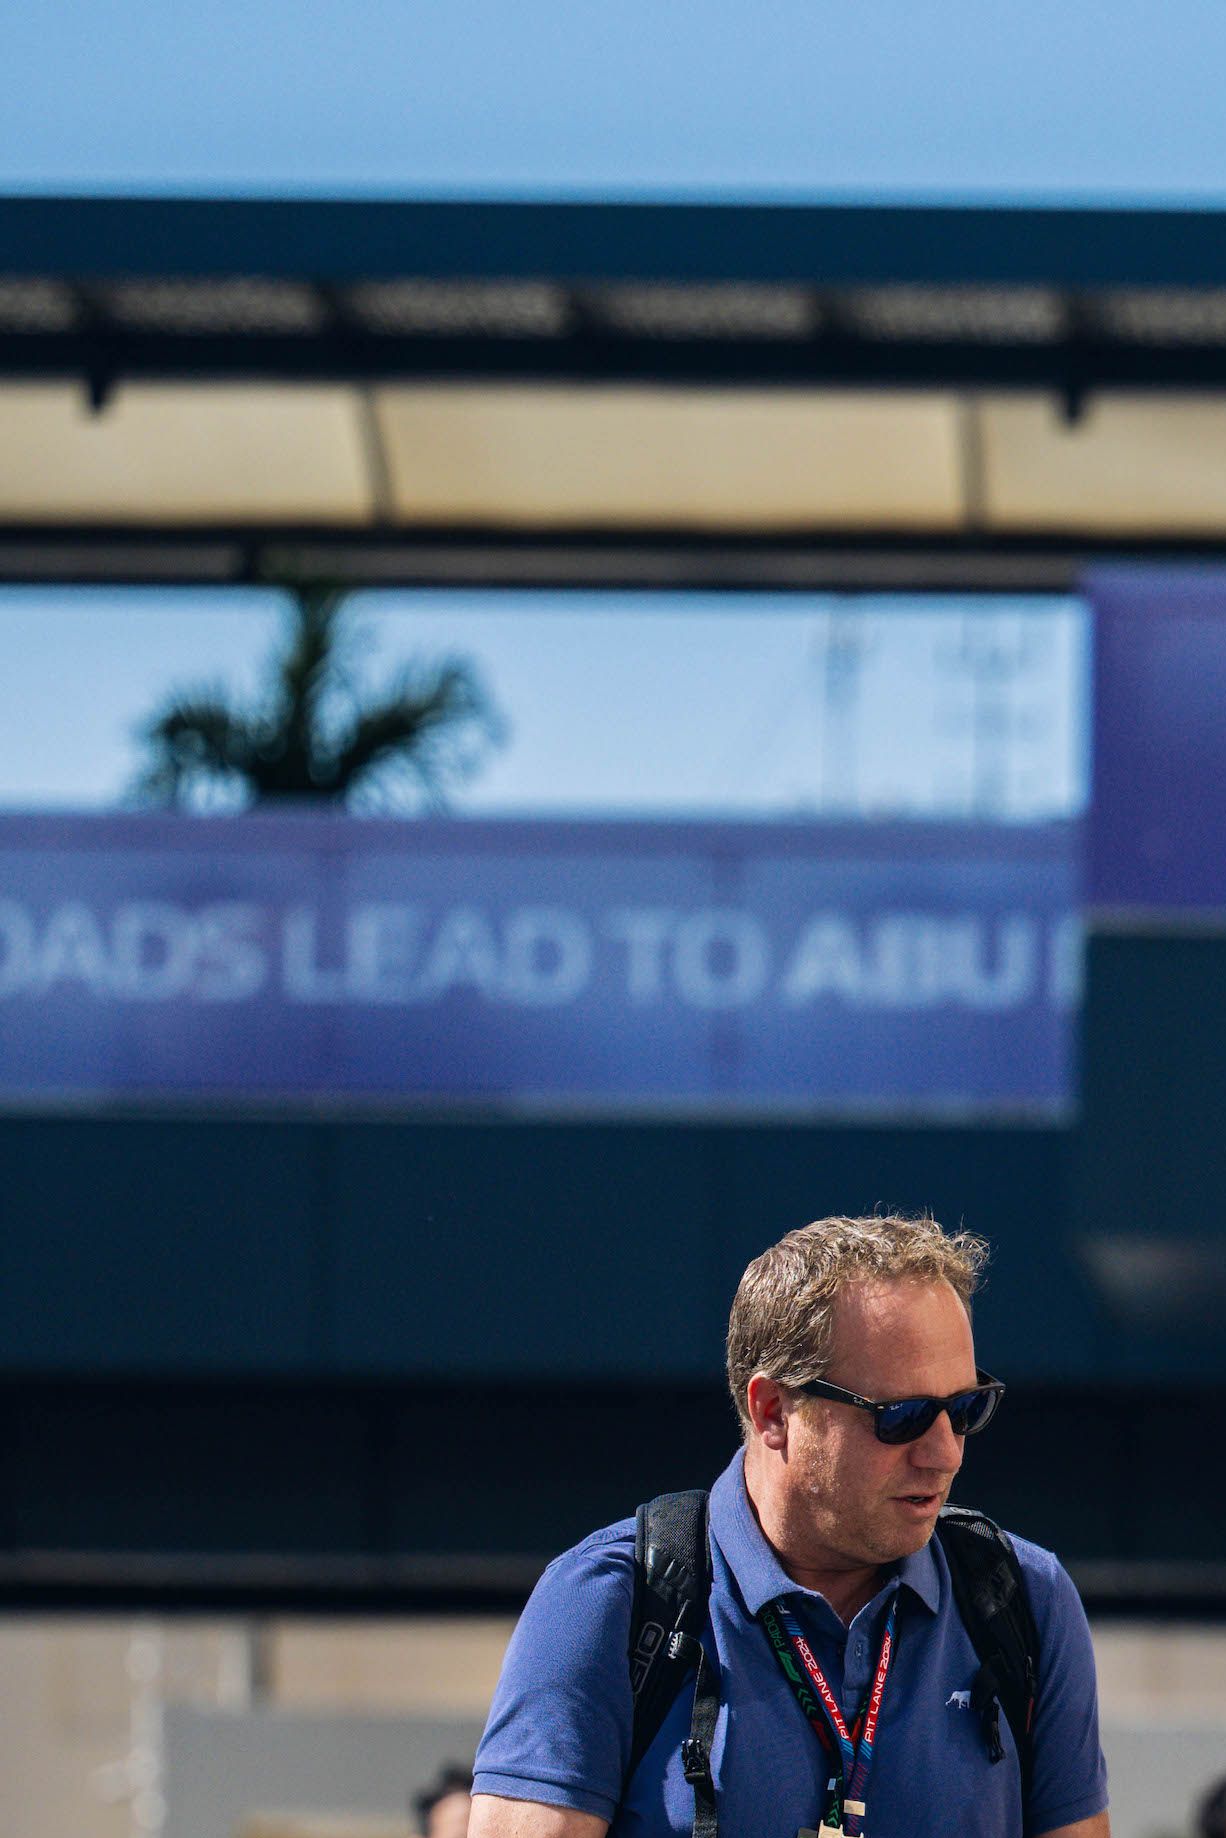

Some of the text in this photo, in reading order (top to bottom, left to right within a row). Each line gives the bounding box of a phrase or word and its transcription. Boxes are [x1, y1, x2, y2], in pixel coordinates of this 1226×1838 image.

[281, 903, 592, 1002] LEAD
[612, 905, 773, 1005] TO
[796, 1636, 849, 1740] PIT LANE 2024
[869, 1671, 886, 1714] LANE
[864, 1717, 876, 1743] PIT
